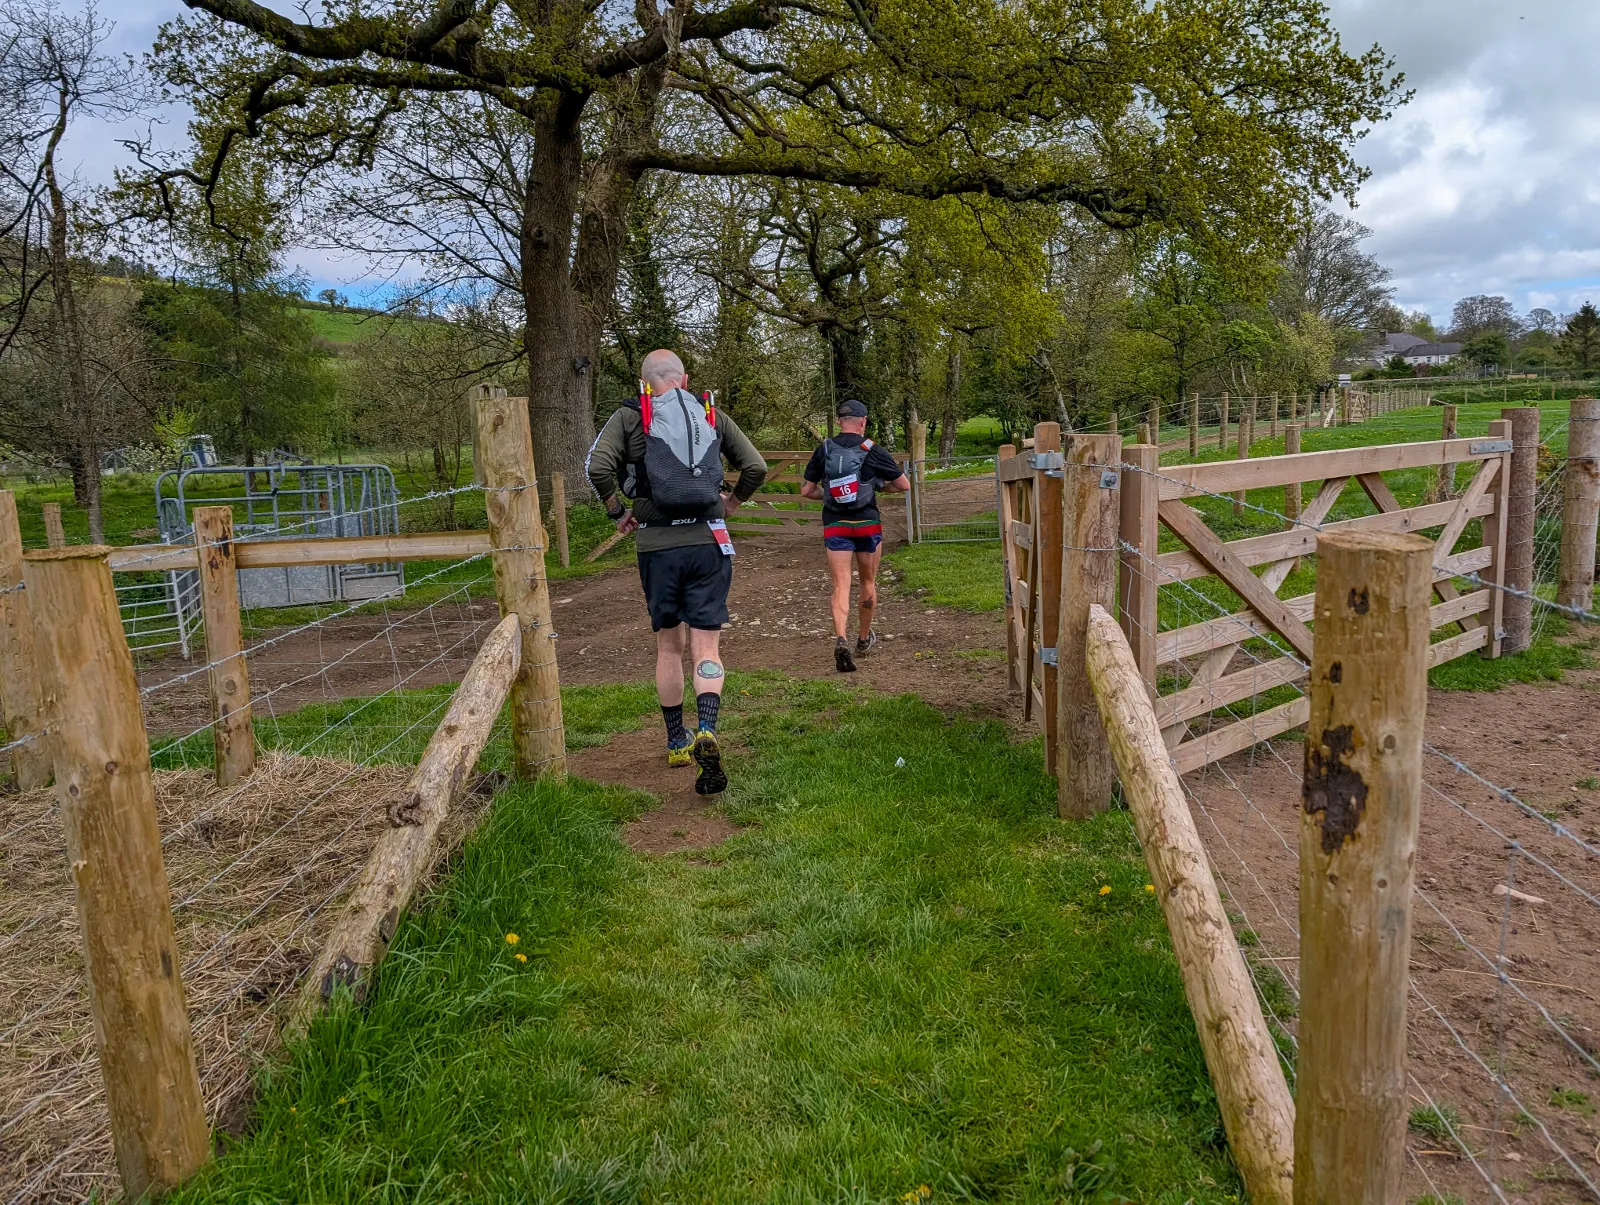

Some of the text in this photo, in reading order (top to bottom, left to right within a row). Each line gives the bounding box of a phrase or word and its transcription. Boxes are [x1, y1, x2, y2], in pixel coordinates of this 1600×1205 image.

[690, 410, 700, 446] SALOMON
[839, 485, 851, 496] 16
[671, 518, 697, 526] 2XU
